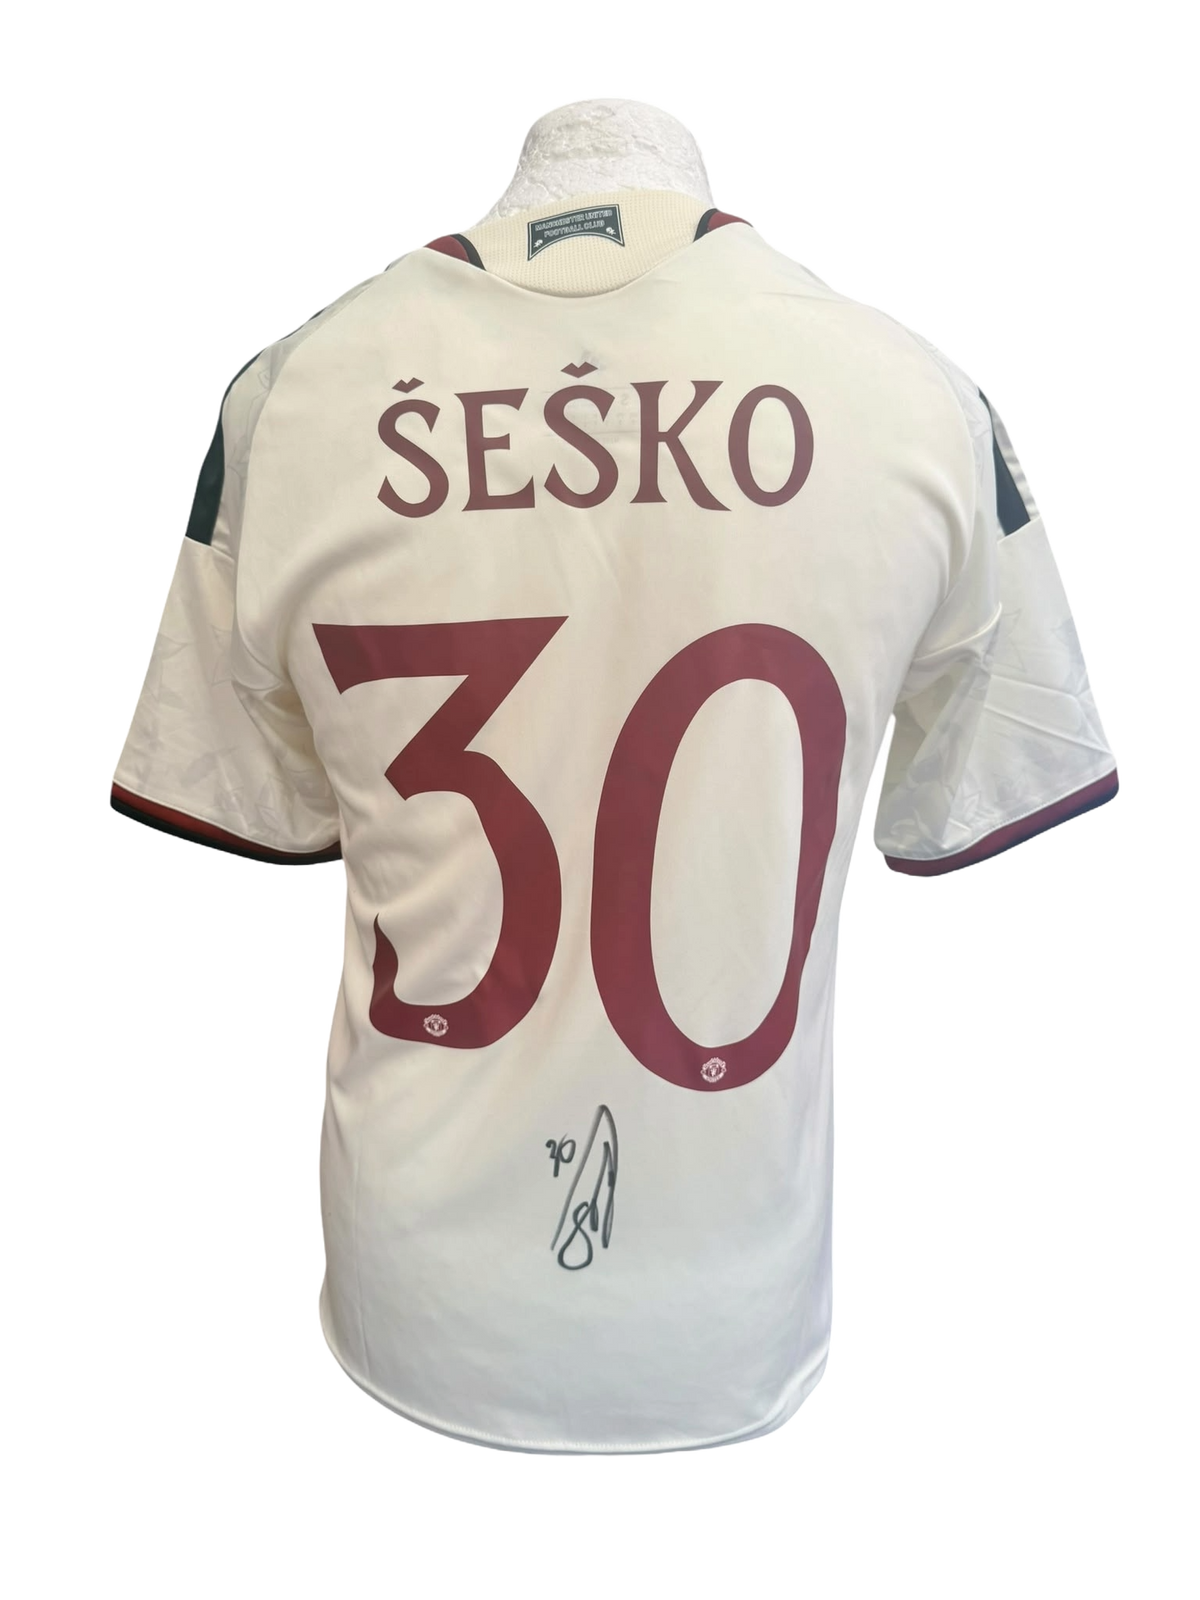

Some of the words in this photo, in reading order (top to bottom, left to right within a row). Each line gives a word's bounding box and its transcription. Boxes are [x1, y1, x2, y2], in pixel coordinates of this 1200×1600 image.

[534, 213, 585, 231] MANCHESTER
[585, 209, 613, 220] UNITED
[543, 224, 583, 238] FOOTBALL
[583, 219, 605, 231] CLUB
[377, 361, 814, 518] ŠEŠKO
[313, 615, 847, 1093] 30
